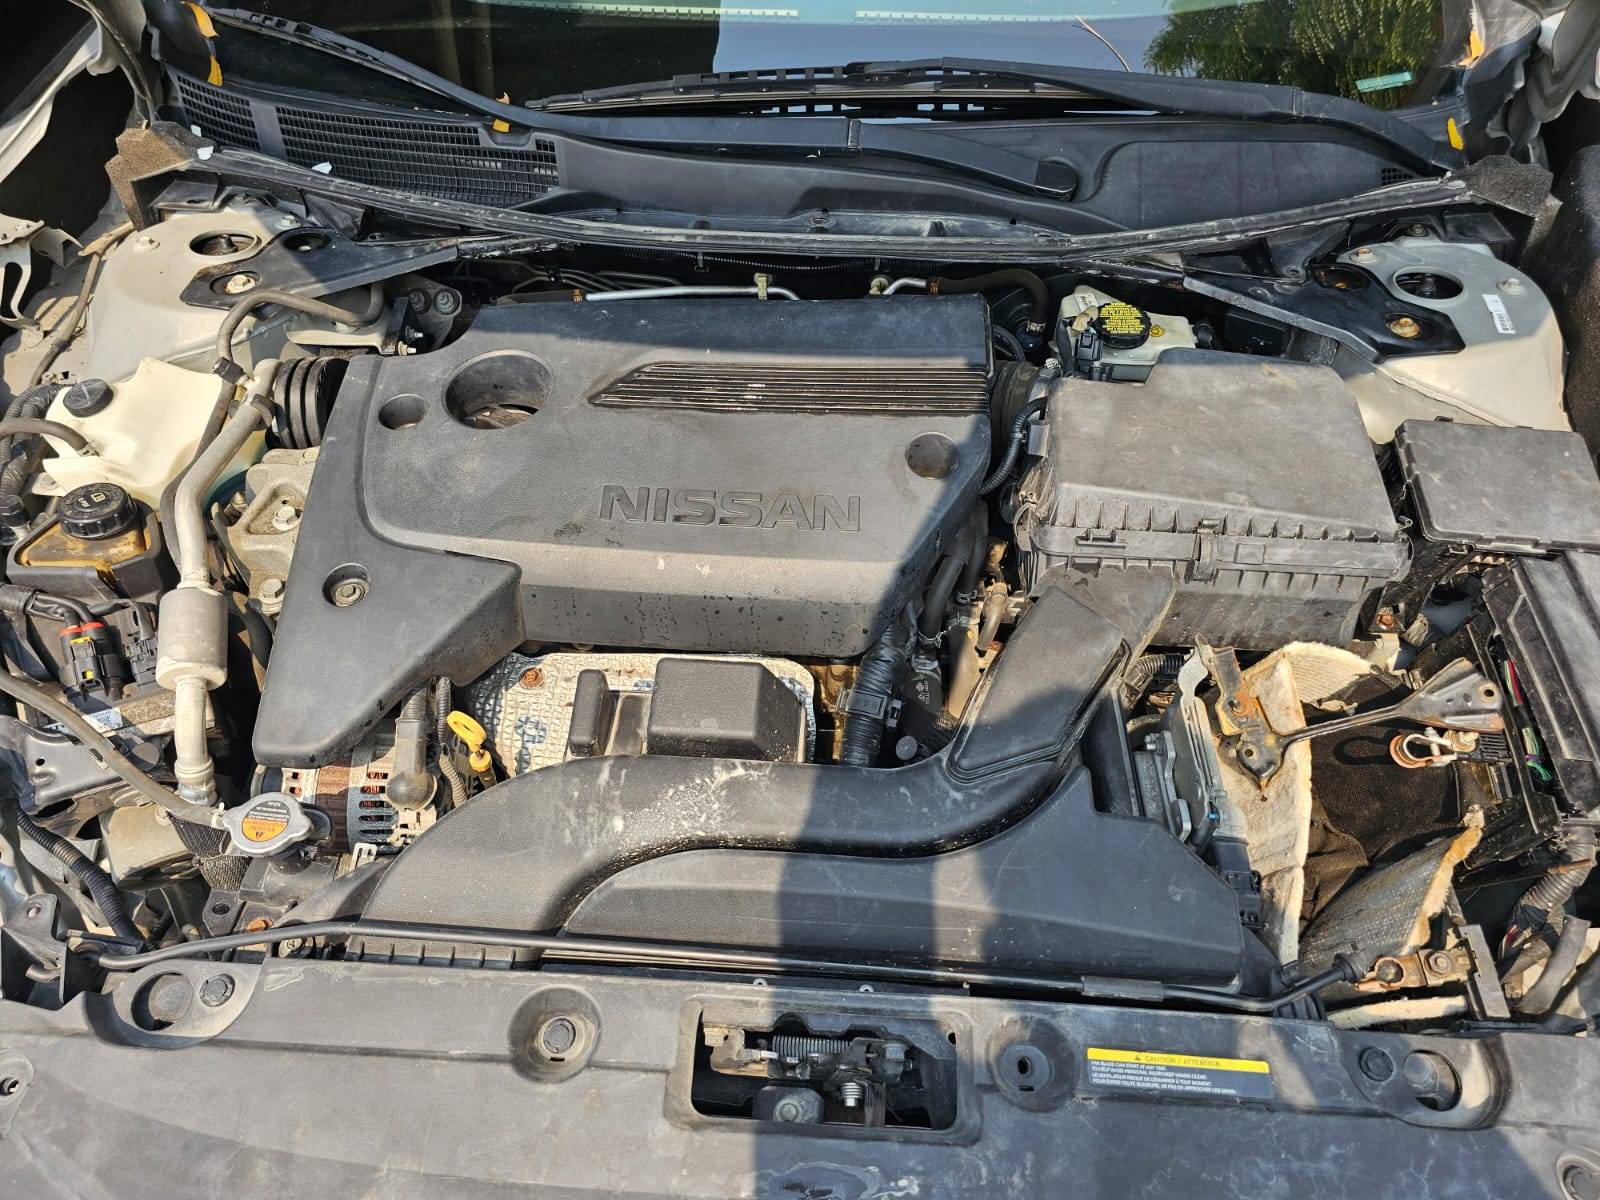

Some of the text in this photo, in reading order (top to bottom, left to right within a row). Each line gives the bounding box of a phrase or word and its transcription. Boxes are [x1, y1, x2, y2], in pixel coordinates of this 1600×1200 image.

[599, 484, 860, 532] NISSAN
[1145, 1055, 1176, 1064] CAUTION
[1183, 1058, 1222, 1067] ATTENTION
